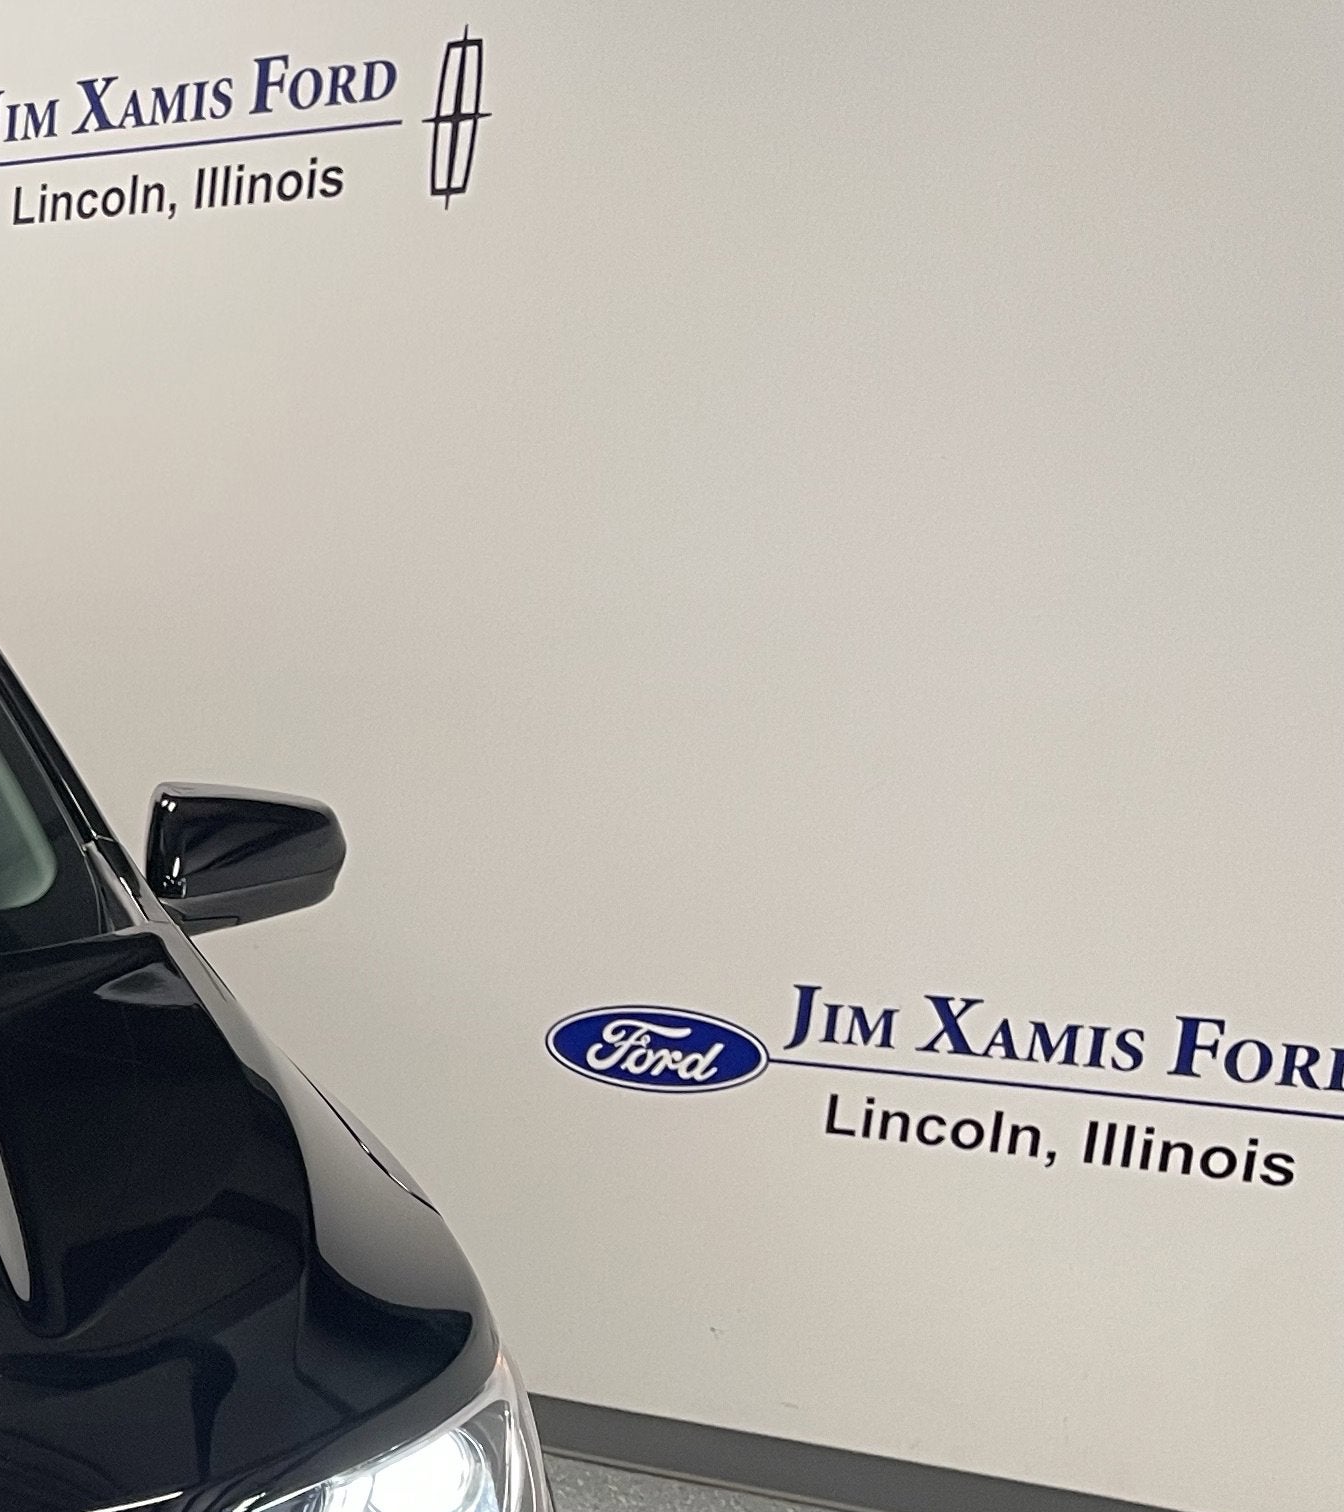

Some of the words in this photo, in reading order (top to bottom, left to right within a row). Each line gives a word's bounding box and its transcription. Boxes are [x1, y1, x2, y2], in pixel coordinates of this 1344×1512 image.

[11, 174, 176, 226] Lincoln,
[193, 156, 344, 209] Illinois
[585, 1017, 718, 1083] Ford
[824, 1093, 1058, 1168] Lincoln,
[1081, 1120, 1296, 1187] Illinois
